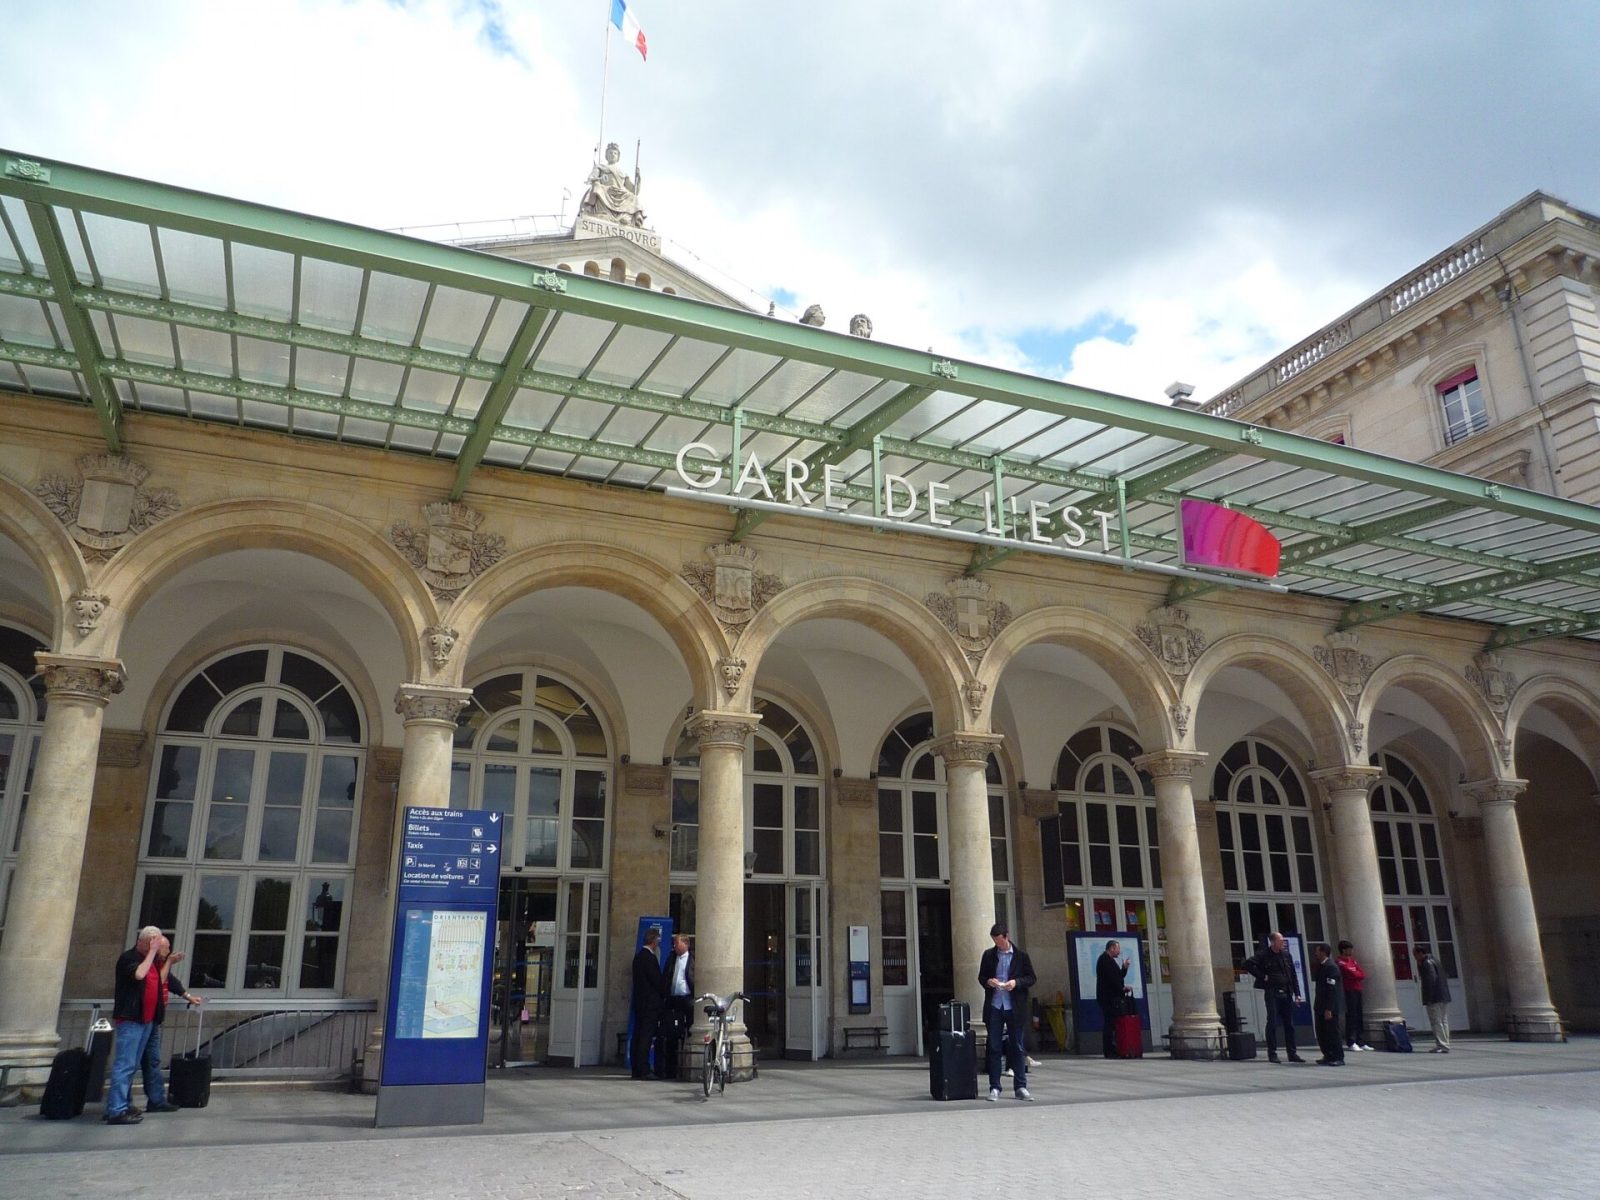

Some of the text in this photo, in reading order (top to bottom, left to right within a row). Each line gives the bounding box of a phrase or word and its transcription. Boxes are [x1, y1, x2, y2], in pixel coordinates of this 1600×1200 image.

[581, 220, 657, 247] STRASBOVRG
[676, 442, 1114, 551] GARE DE L'EST
[409, 808, 429, 816] Accès
[408, 823, 430, 832] Billets
[407, 841, 424, 849] Taxis
